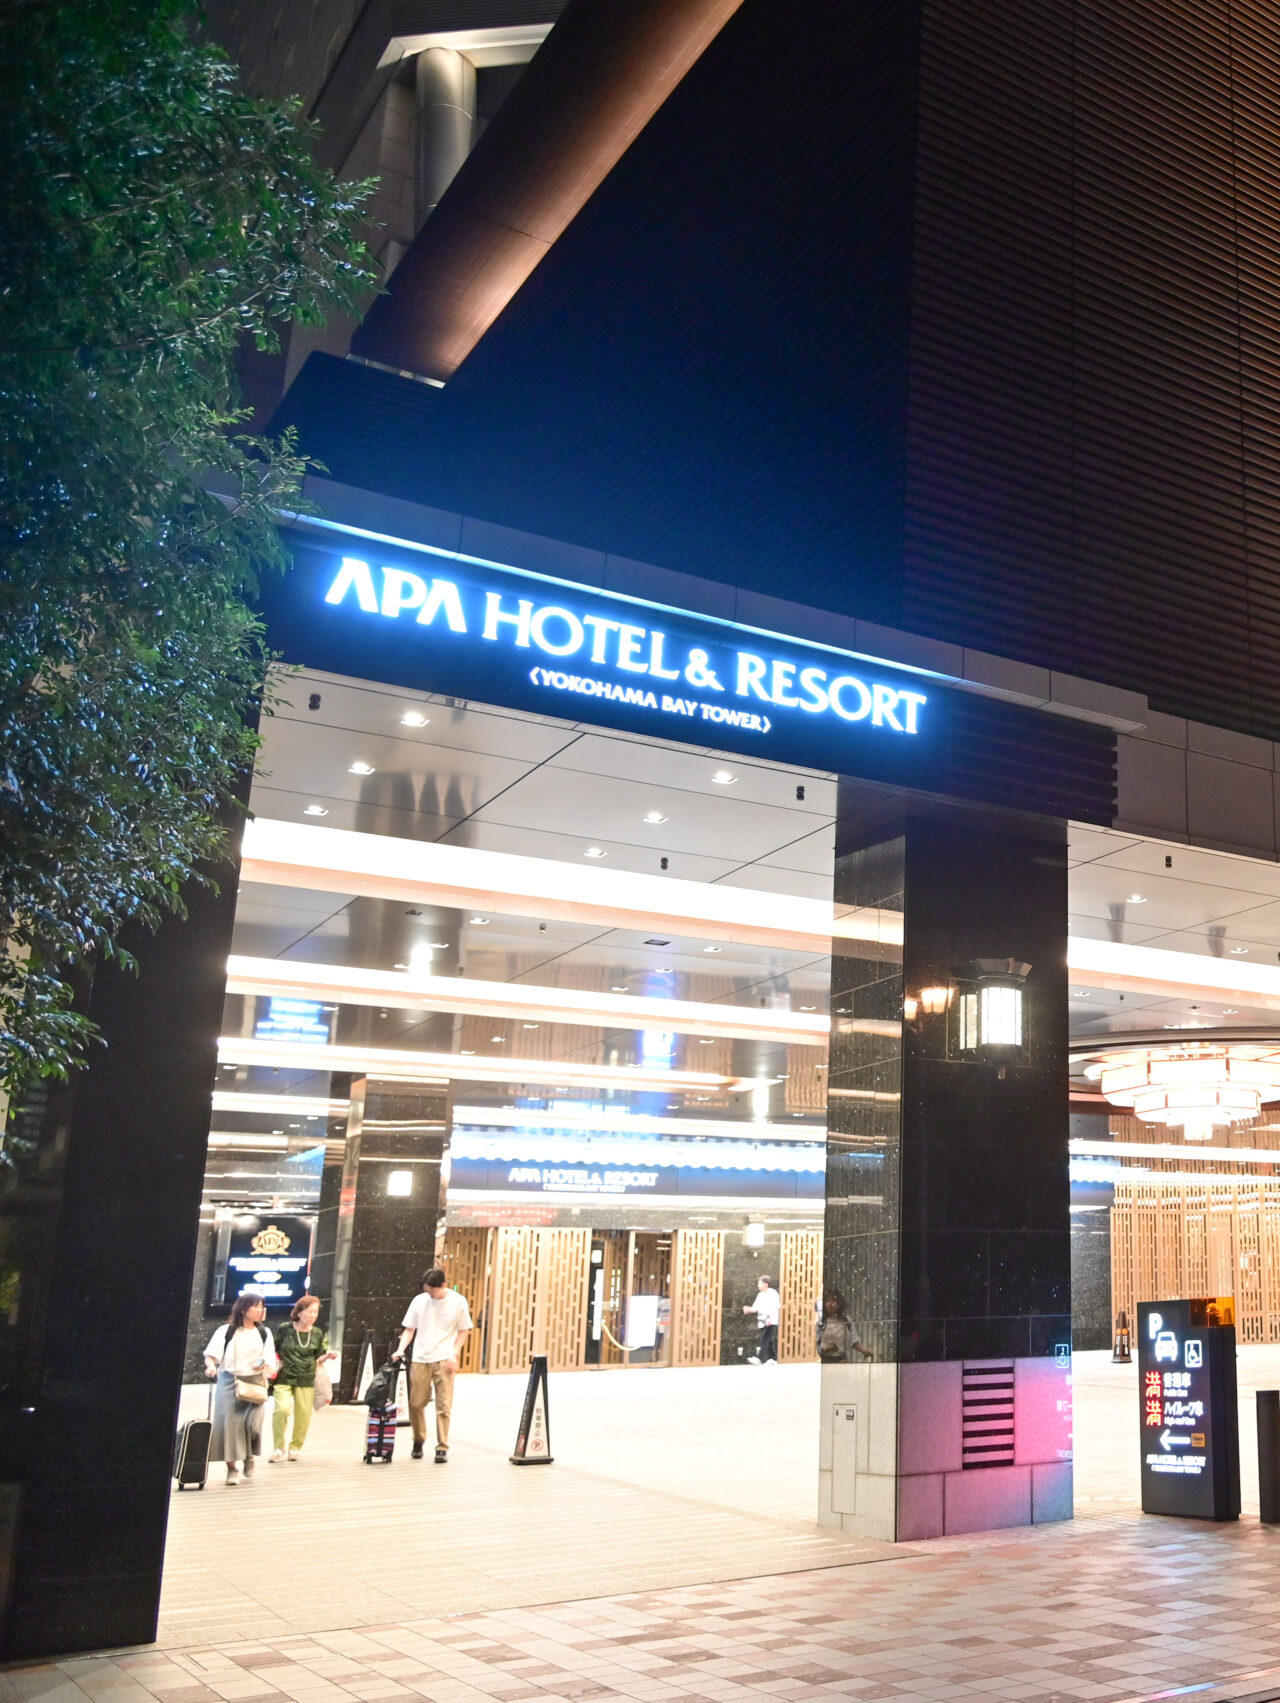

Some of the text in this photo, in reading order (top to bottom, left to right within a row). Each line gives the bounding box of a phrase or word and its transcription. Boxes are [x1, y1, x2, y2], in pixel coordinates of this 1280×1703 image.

[325, 556, 928, 734] APA HOTEL & RESORT
[660, 694, 698, 720] BAY
[507, 1167, 541, 1183] APA
[542, 1168, 590, 1185] HOTEL
